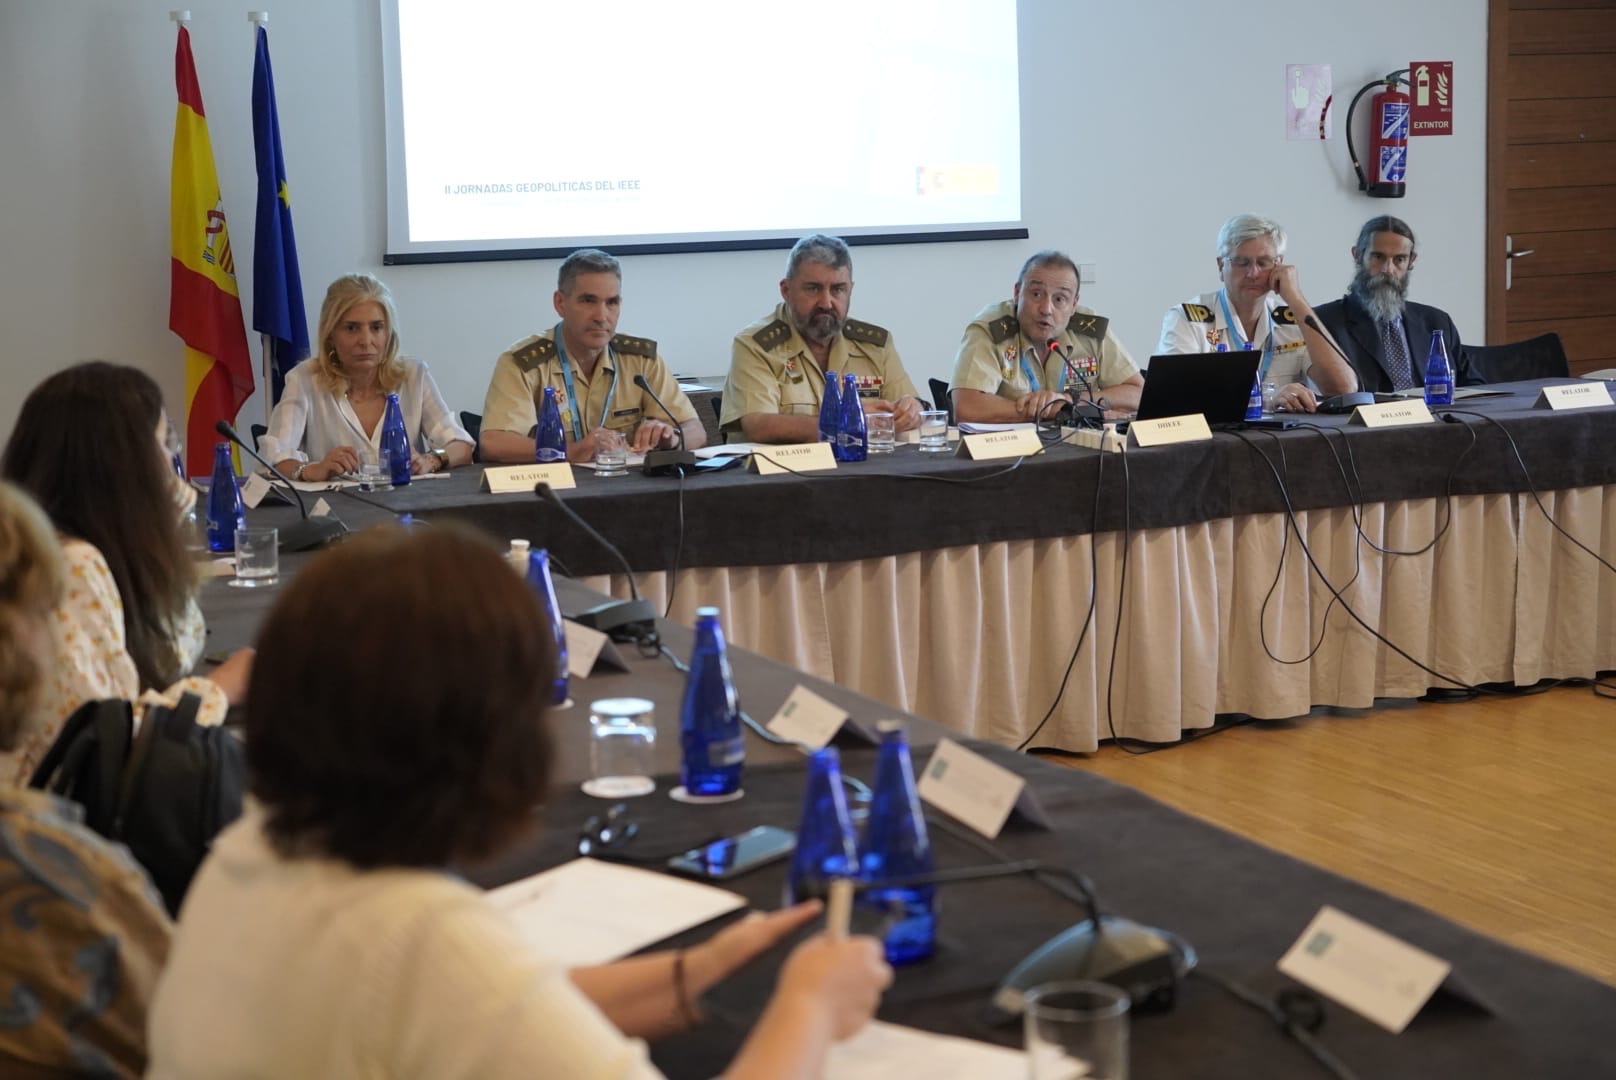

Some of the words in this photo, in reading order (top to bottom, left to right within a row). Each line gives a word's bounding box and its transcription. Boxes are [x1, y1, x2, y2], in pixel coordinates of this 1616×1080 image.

[1413, 121, 1449, 129] EXTINTOR
[444, 185, 451, 195] II
[453, 183, 513, 194] JORNADAS
[595, 180, 615, 191] DEL
[618, 180, 641, 190] IEEE
[1561, 387, 1591, 396] RELATOR
[985, 435, 1018, 443] RELATOR
[776, 447, 811, 456] RELATOR
[510, 472, 550, 481] RELATOR
